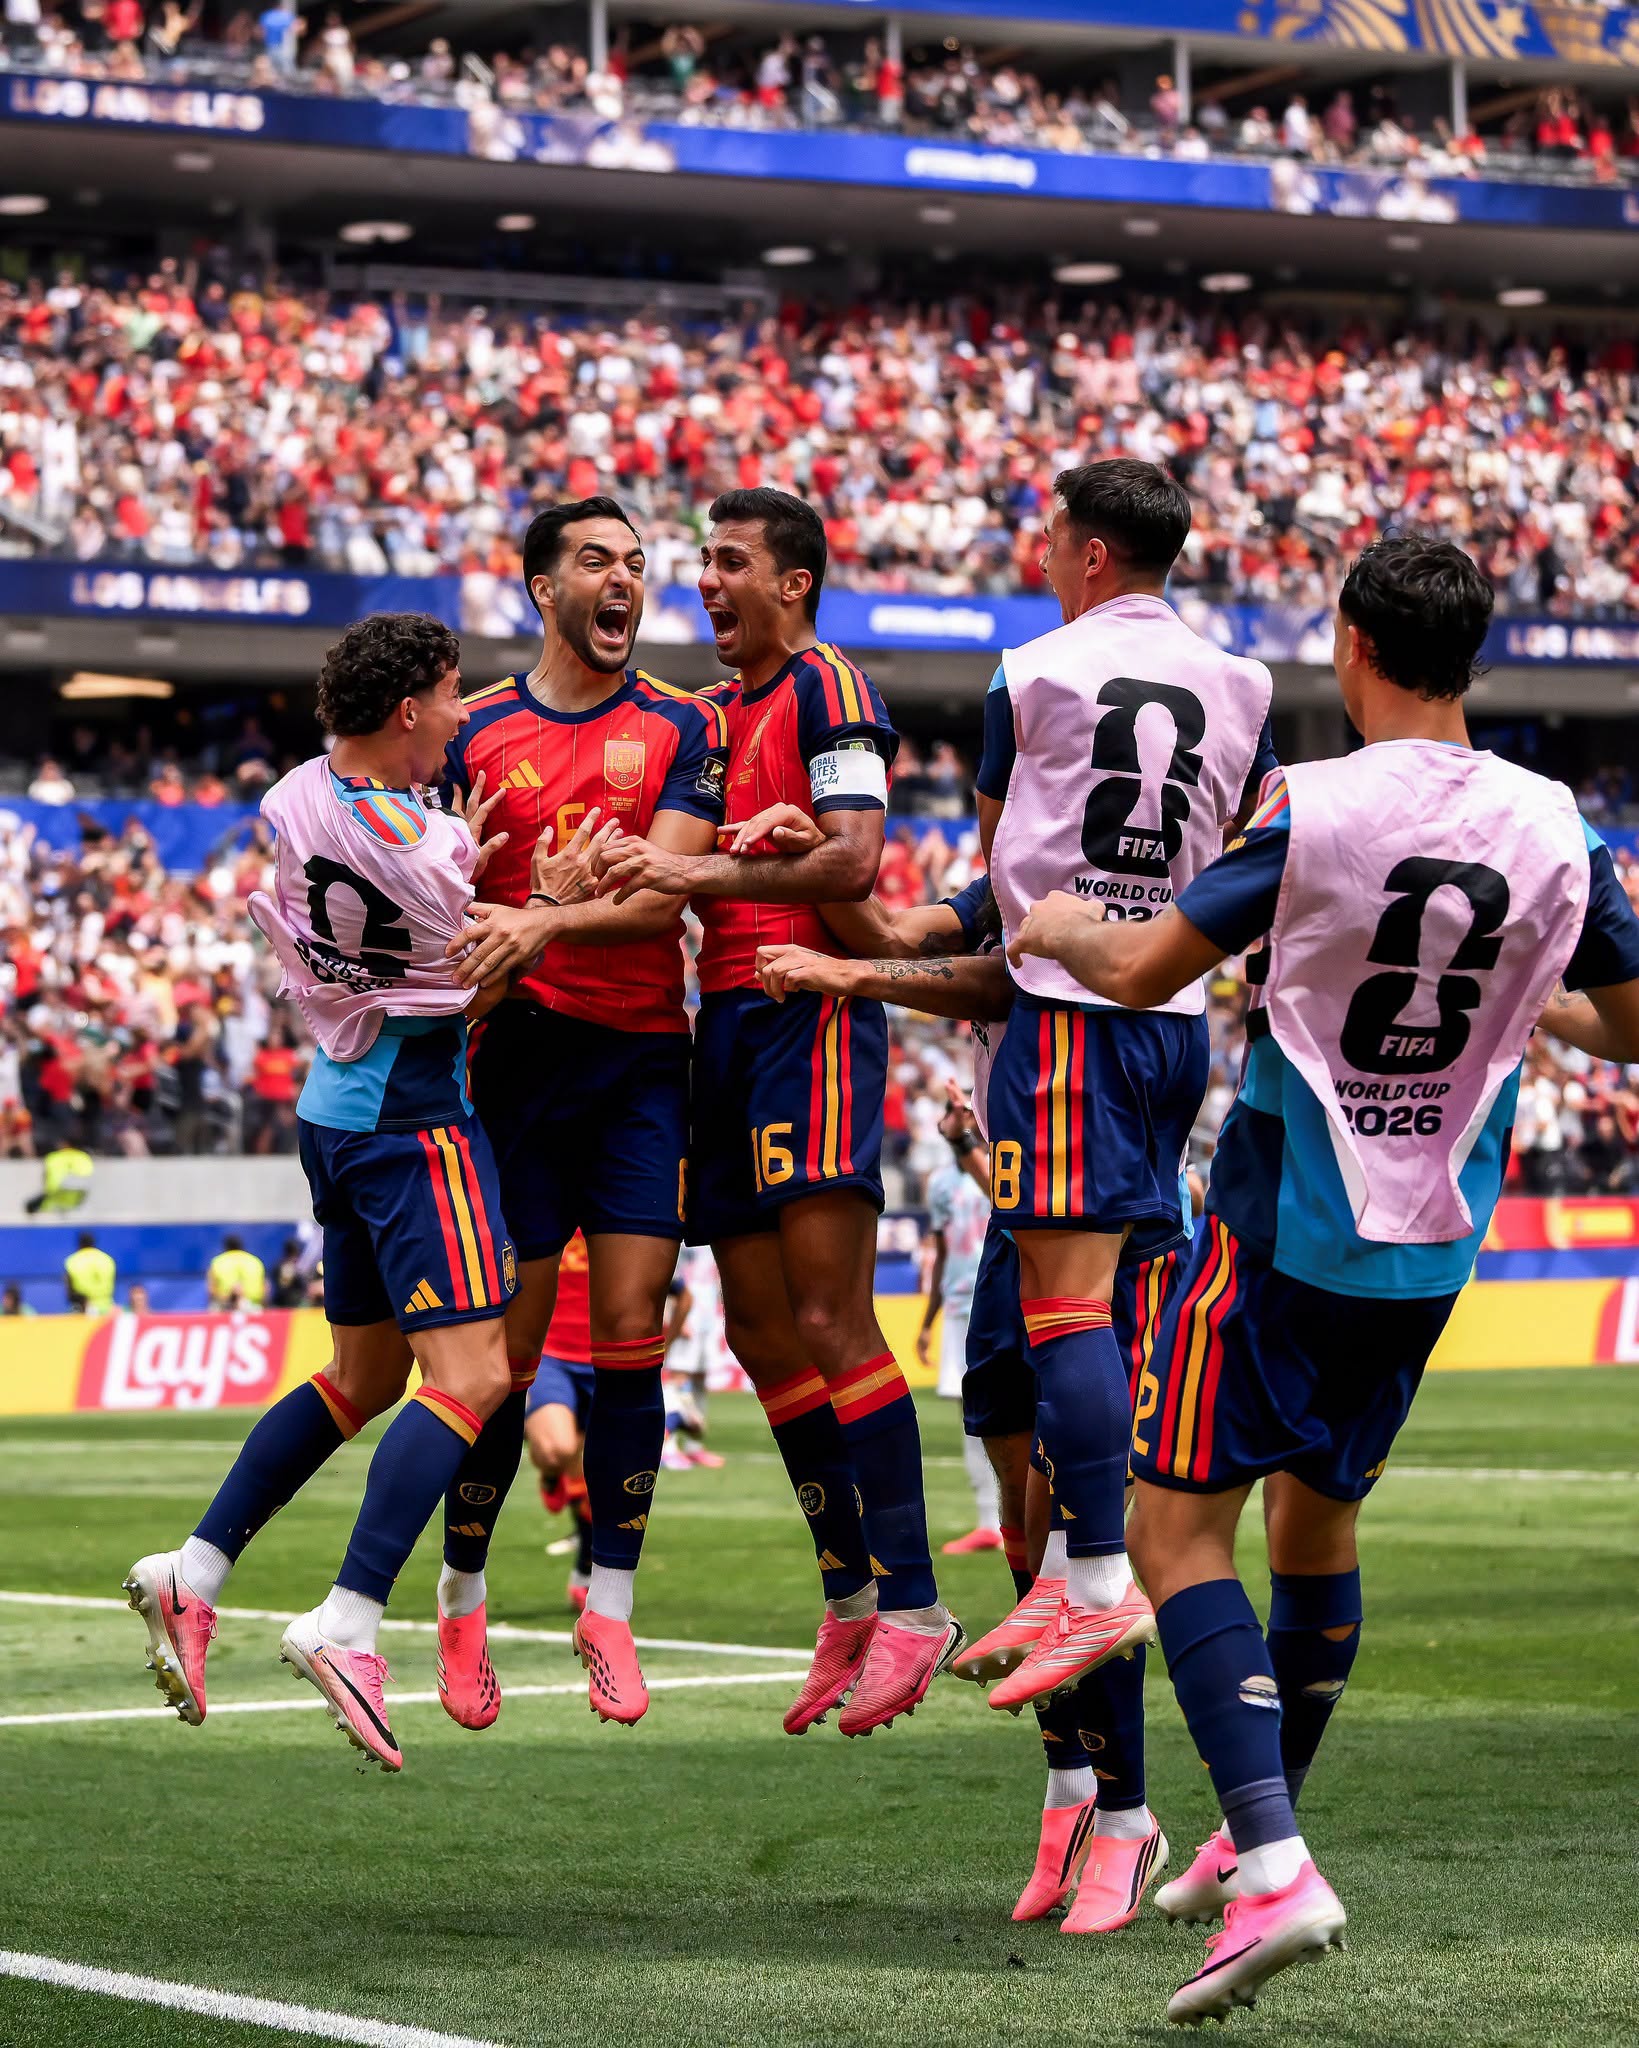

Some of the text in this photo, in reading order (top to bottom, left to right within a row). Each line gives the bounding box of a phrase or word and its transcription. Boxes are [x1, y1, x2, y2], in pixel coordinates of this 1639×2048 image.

[1117, 836, 1166, 861] FIFA
[1074, 876, 1174, 904] WORLD CU
[1379, 1034, 1437, 1057] FIFA
[1333, 1079, 1451, 1101] WORLD CUP
[751, 1122, 794, 1193] 16
[102, 1312, 271, 1410] Lay's
